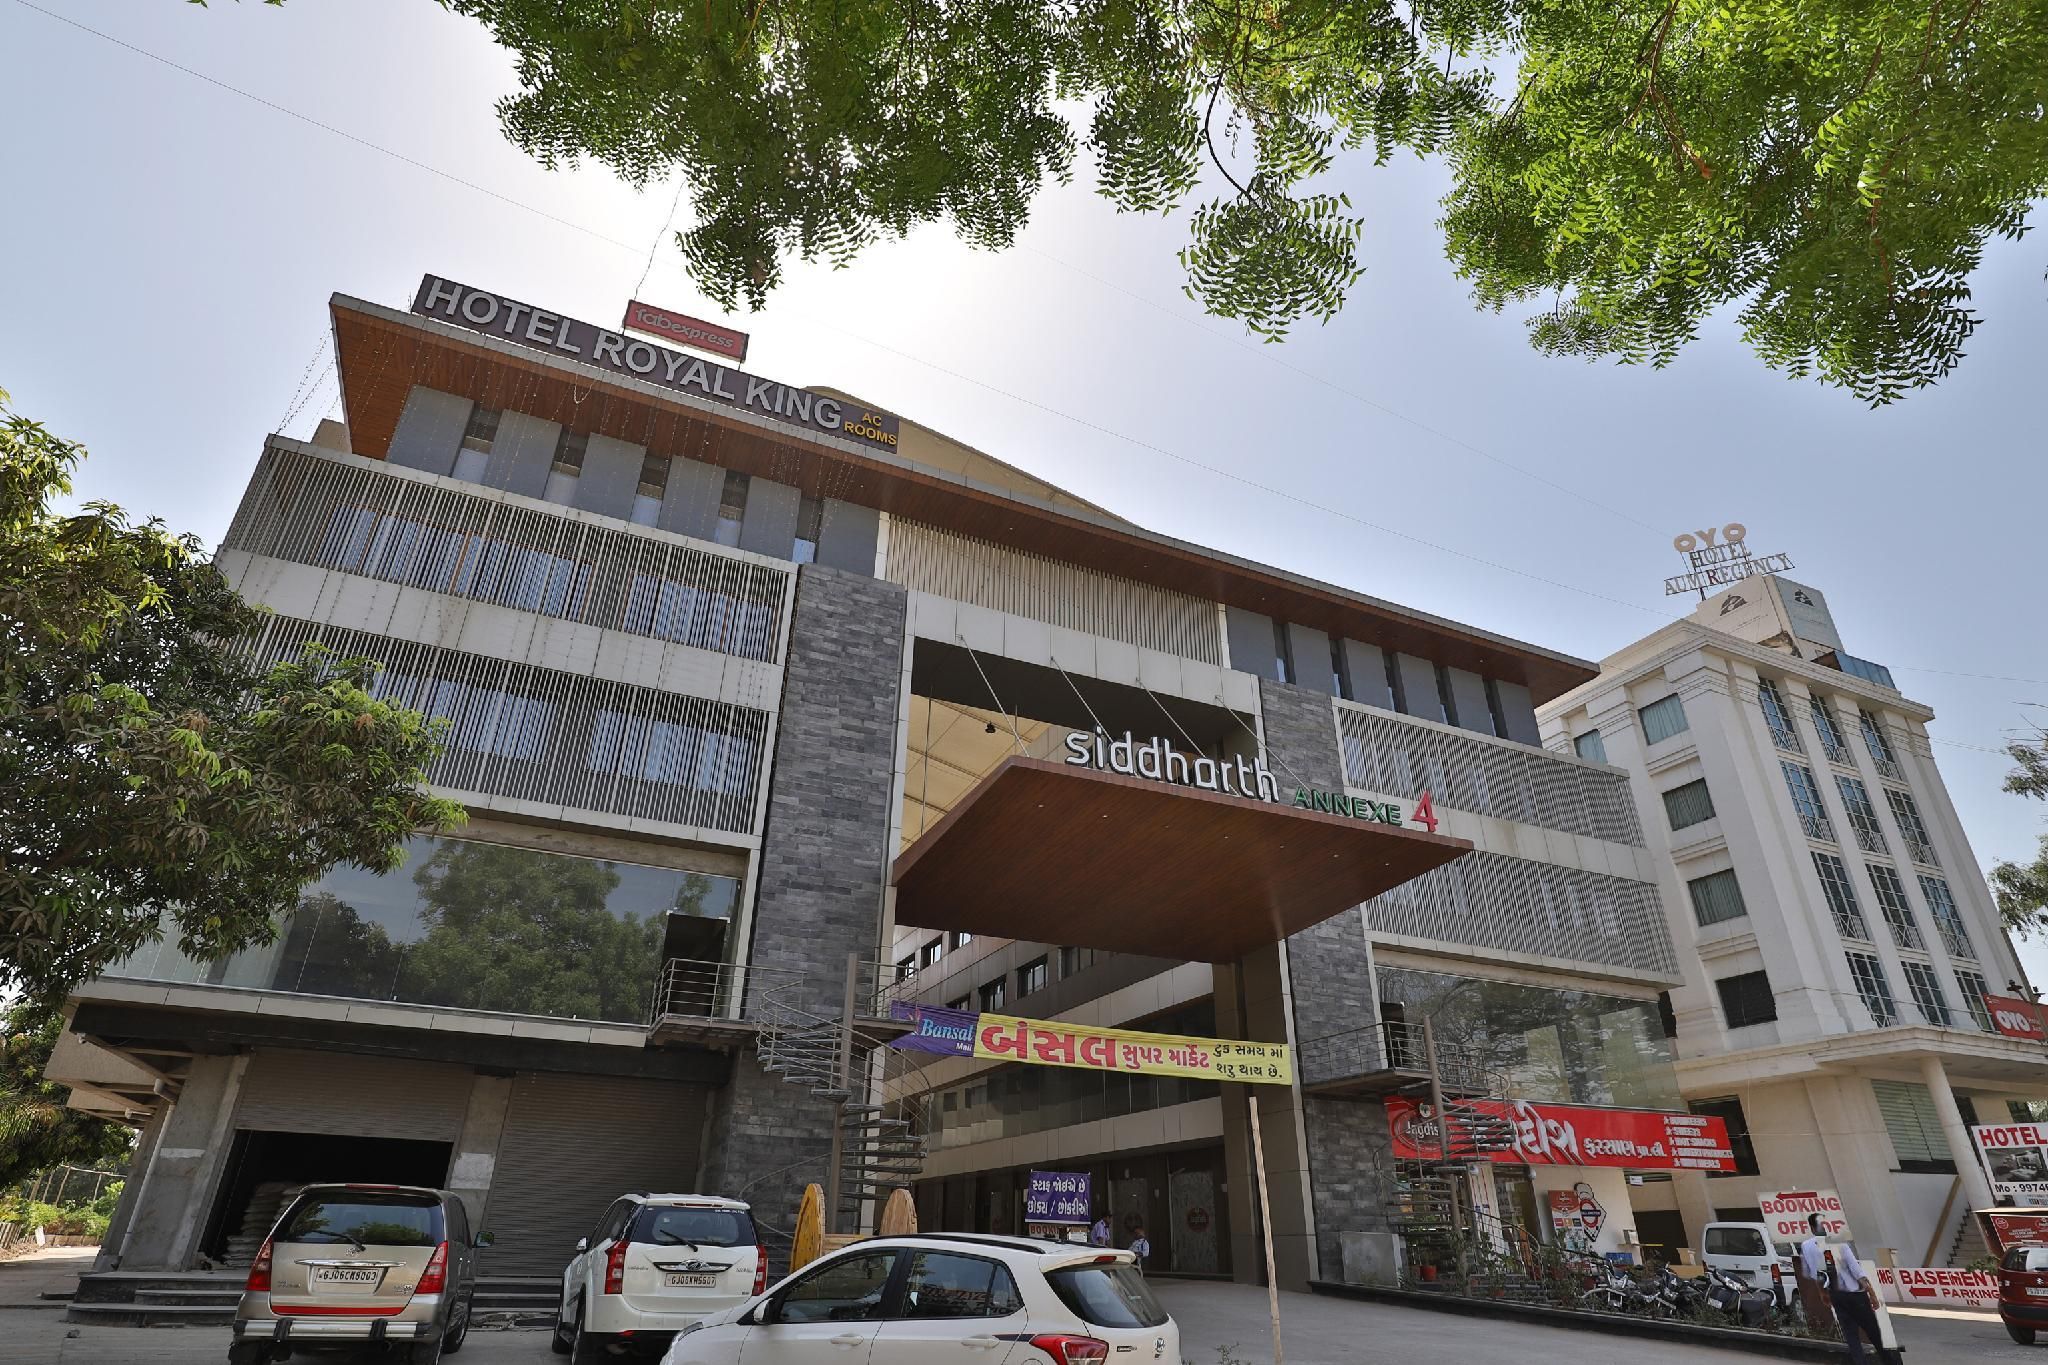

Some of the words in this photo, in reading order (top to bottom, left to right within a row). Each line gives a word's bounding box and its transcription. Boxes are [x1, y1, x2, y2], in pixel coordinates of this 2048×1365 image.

[635, 307, 734, 348] fabexpress
[424, 278, 582, 354] HOTEL
[593, 330, 735, 400] ROYAL
[745, 379, 842, 429] KING
[862, 411, 882, 427] AC
[844, 420, 897, 446] ROOMS
[1673, 522, 1747, 553] OYO
[1689, 539, 1752, 569] HOTEL
[1664, 571, 1703, 596] AUM
[1705, 552, 1795, 586] REGENCY
[1065, 725, 1280, 803] siddharth
[1293, 787, 1403, 827] ANNEXE
[1410, 788, 1439, 834] 4
[921, 1018, 975, 1042] Bansal
[980, 1020, 1118, 1069] બંસલ
[1122, 1044, 1164, 1070] સુપર
[1235, 1045, 1265, 1057] સમય
[1270, 1045, 1283, 1059] માં
[1239, 1065, 1263, 1077] થાય
[1406, 1120, 1440, 1139] Jagdis
[1978, 1126, 2048, 1147] HOTEL
[1078, 1178, 1086, 1193] છે
[1761, 1197, 1842, 1215] BOOKING
[1900, 1269, 2000, 1287] BASEMENT
[1941, 1288, 2000, 1299] PARKING
[1966, 1298, 1981, 1307] IN
